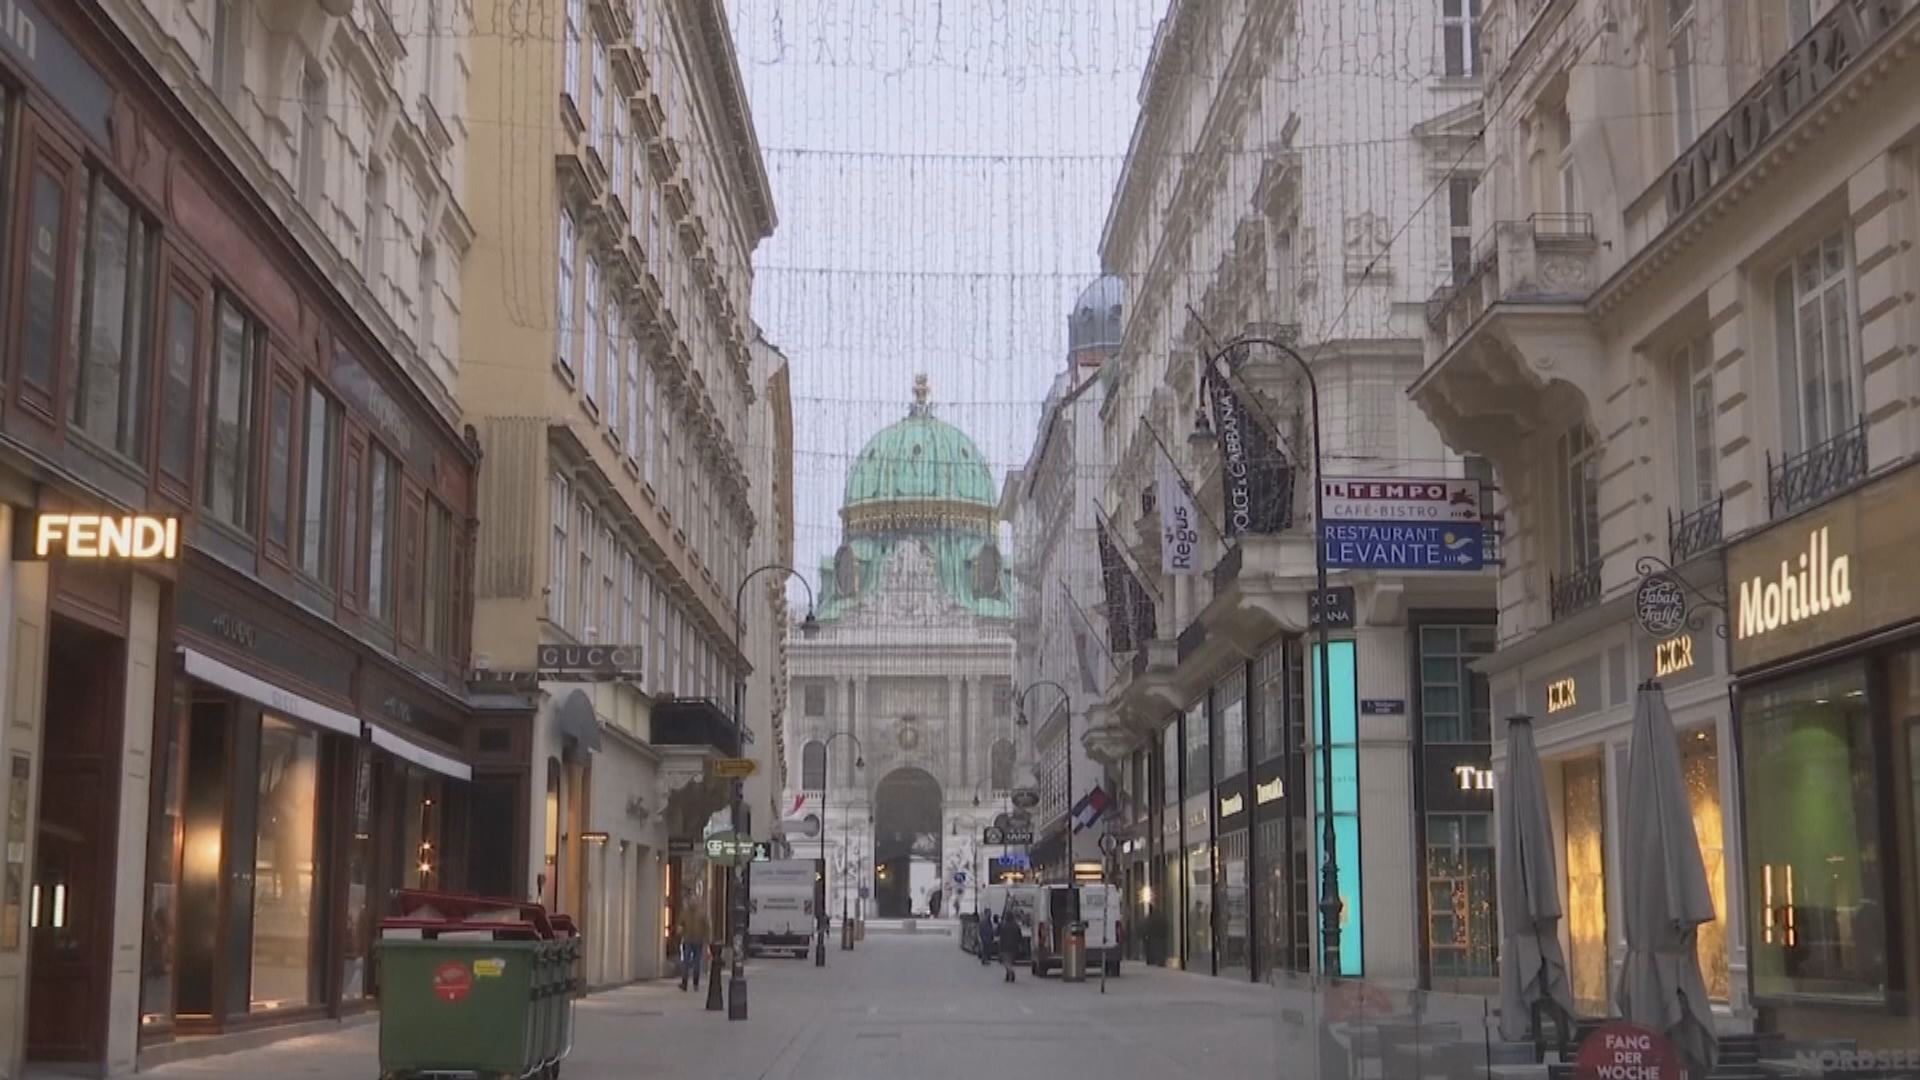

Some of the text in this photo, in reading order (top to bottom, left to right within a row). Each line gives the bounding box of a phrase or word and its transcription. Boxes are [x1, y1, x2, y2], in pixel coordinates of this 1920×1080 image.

[1325, 484, 1444, 499] IL TEMPO
[36, 513, 178, 560] FENDI
[1172, 506, 1198, 570] Regus
[1325, 525, 1440, 542] RESTAURANT
[1325, 543, 1441, 564] LEVANTE
[1738, 526, 1852, 640] Mohilla
[1640, 584, 1682, 606] Tabak
[1641, 605, 1683, 625] Trafik
[543, 648, 639, 666] GUCCI
[1605, 1034, 1651, 1050] FANG
[1614, 1051, 1643, 1064] DER
[1597, 1065, 1660, 1080] WOCHE
